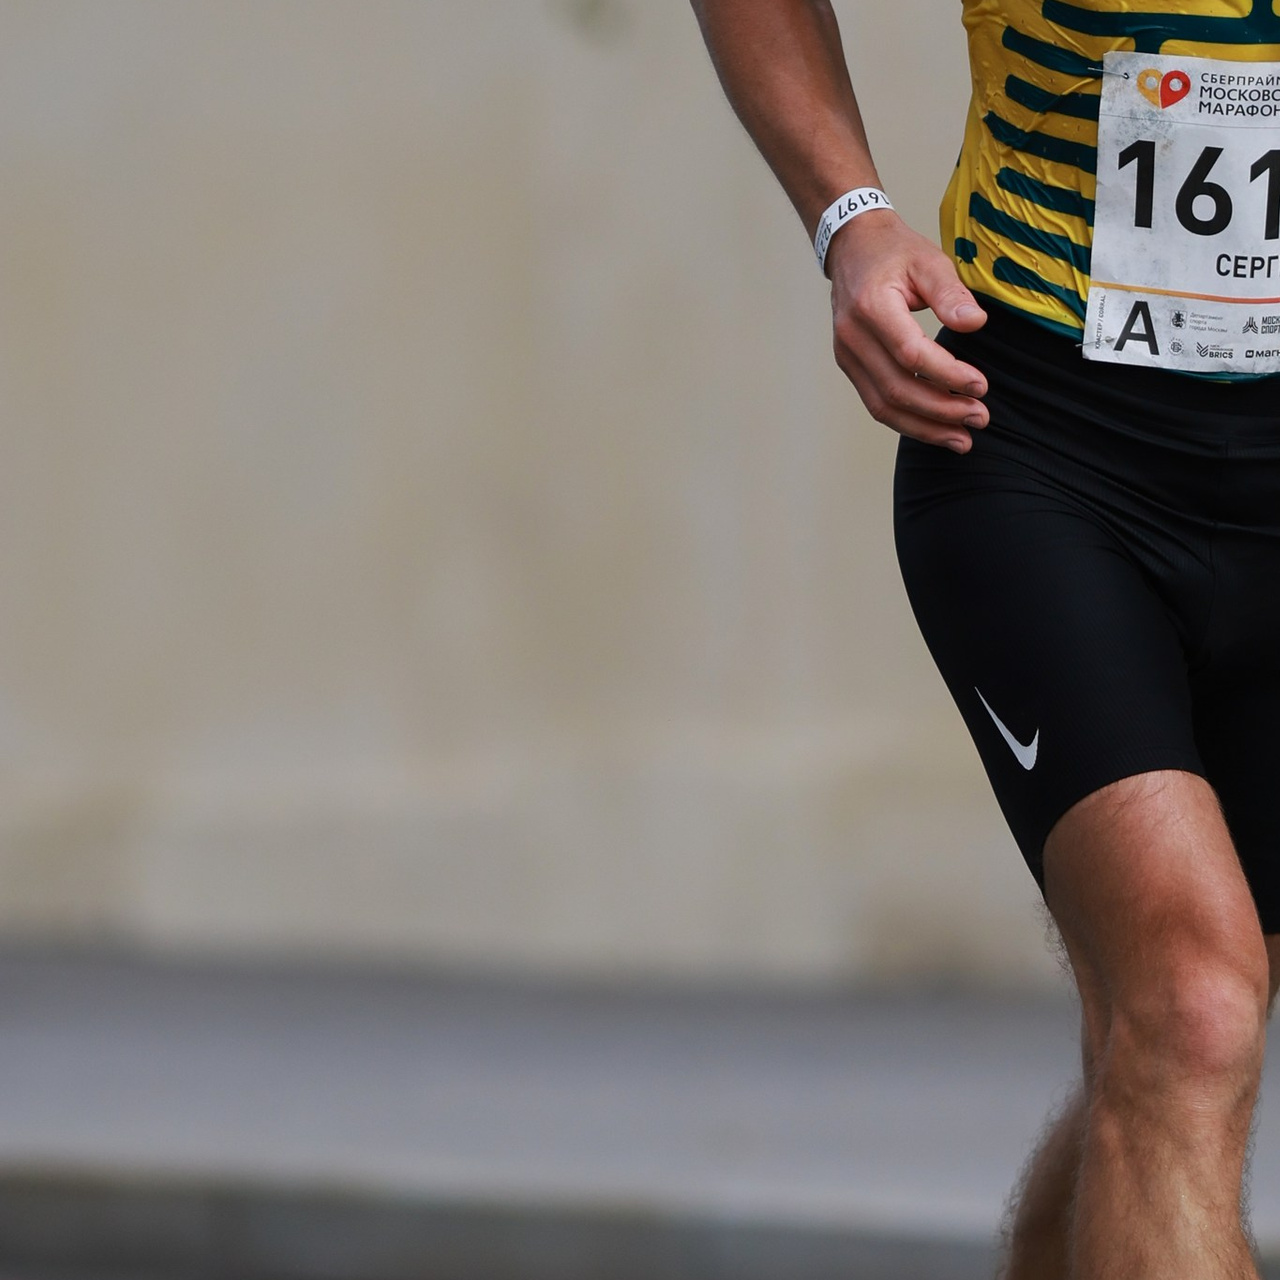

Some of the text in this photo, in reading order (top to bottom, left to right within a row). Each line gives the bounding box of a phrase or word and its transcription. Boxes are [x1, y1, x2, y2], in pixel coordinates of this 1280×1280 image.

[838, 192, 890, 220] 16197
[1113, 300, 1160, 356] A
[1209, 351, 1234, 359] BRICS
